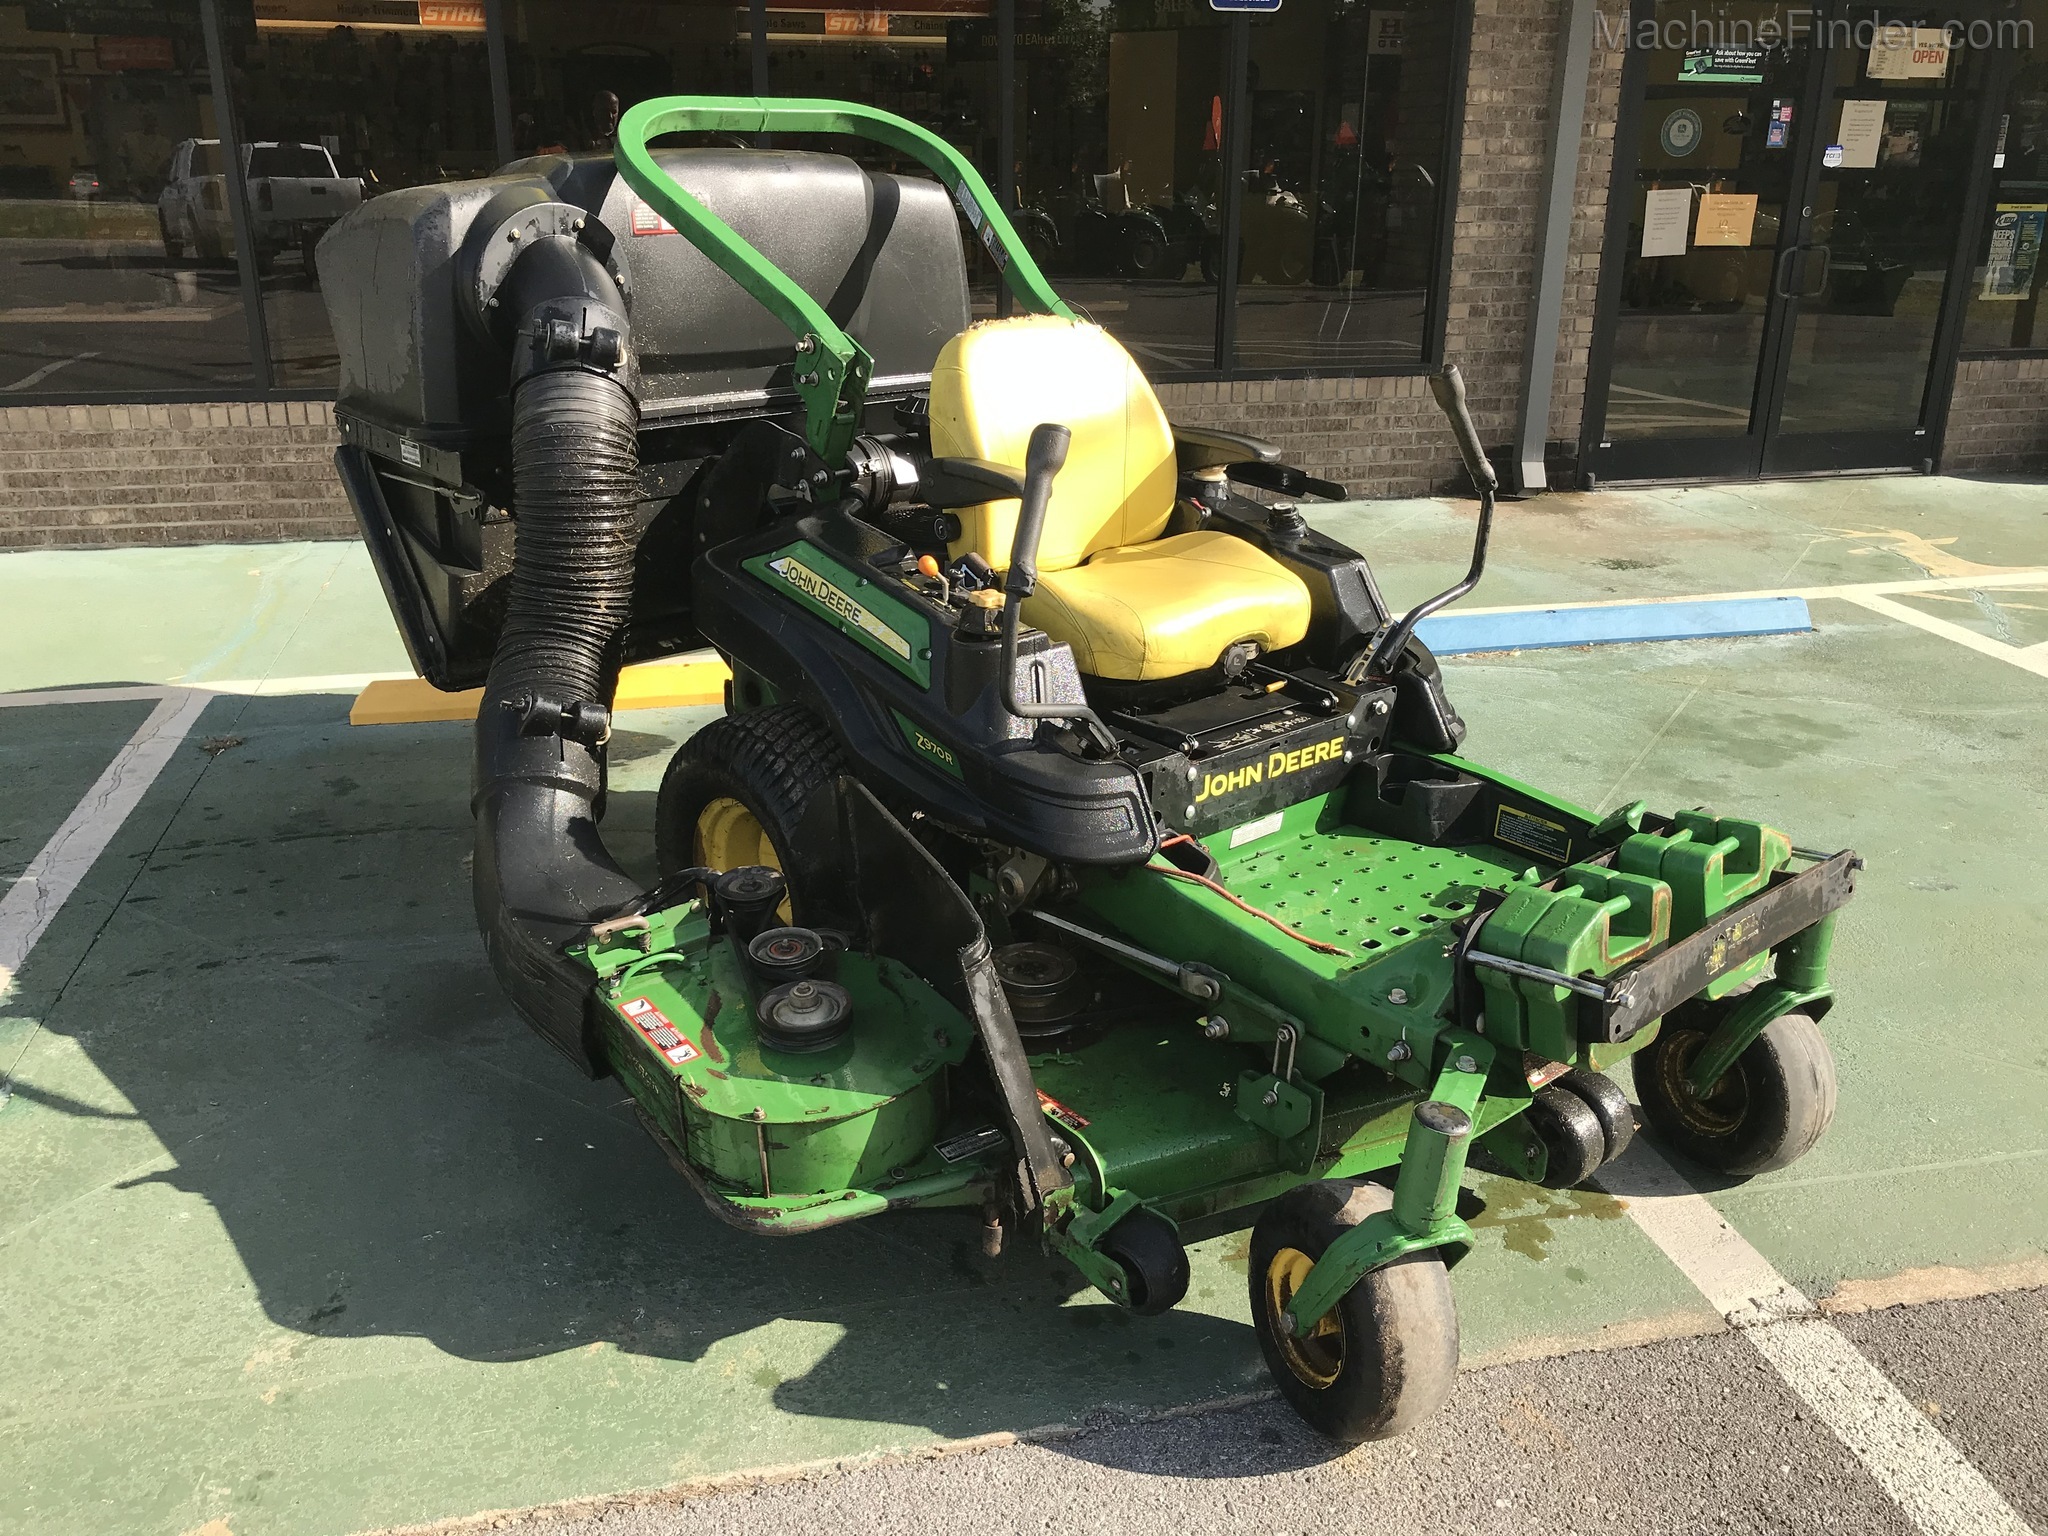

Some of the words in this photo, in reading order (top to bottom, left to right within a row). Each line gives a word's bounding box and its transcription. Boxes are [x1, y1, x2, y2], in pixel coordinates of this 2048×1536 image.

[424, 6, 486, 23] STIHL
[780, 20, 807, 29] Saws
[828, 17, 888, 32] STIHL
[1912, 50, 1945, 63] OPEN
[1993, 229, 2015, 240] KEEPS
[780, 561, 817, 593] JOHN
[817, 581, 862, 625] DEERE
[914, 731, 954, 765] Z970R
[1195, 762, 1263, 803] JOHN
[1268, 736, 1344, 779] DEERE
